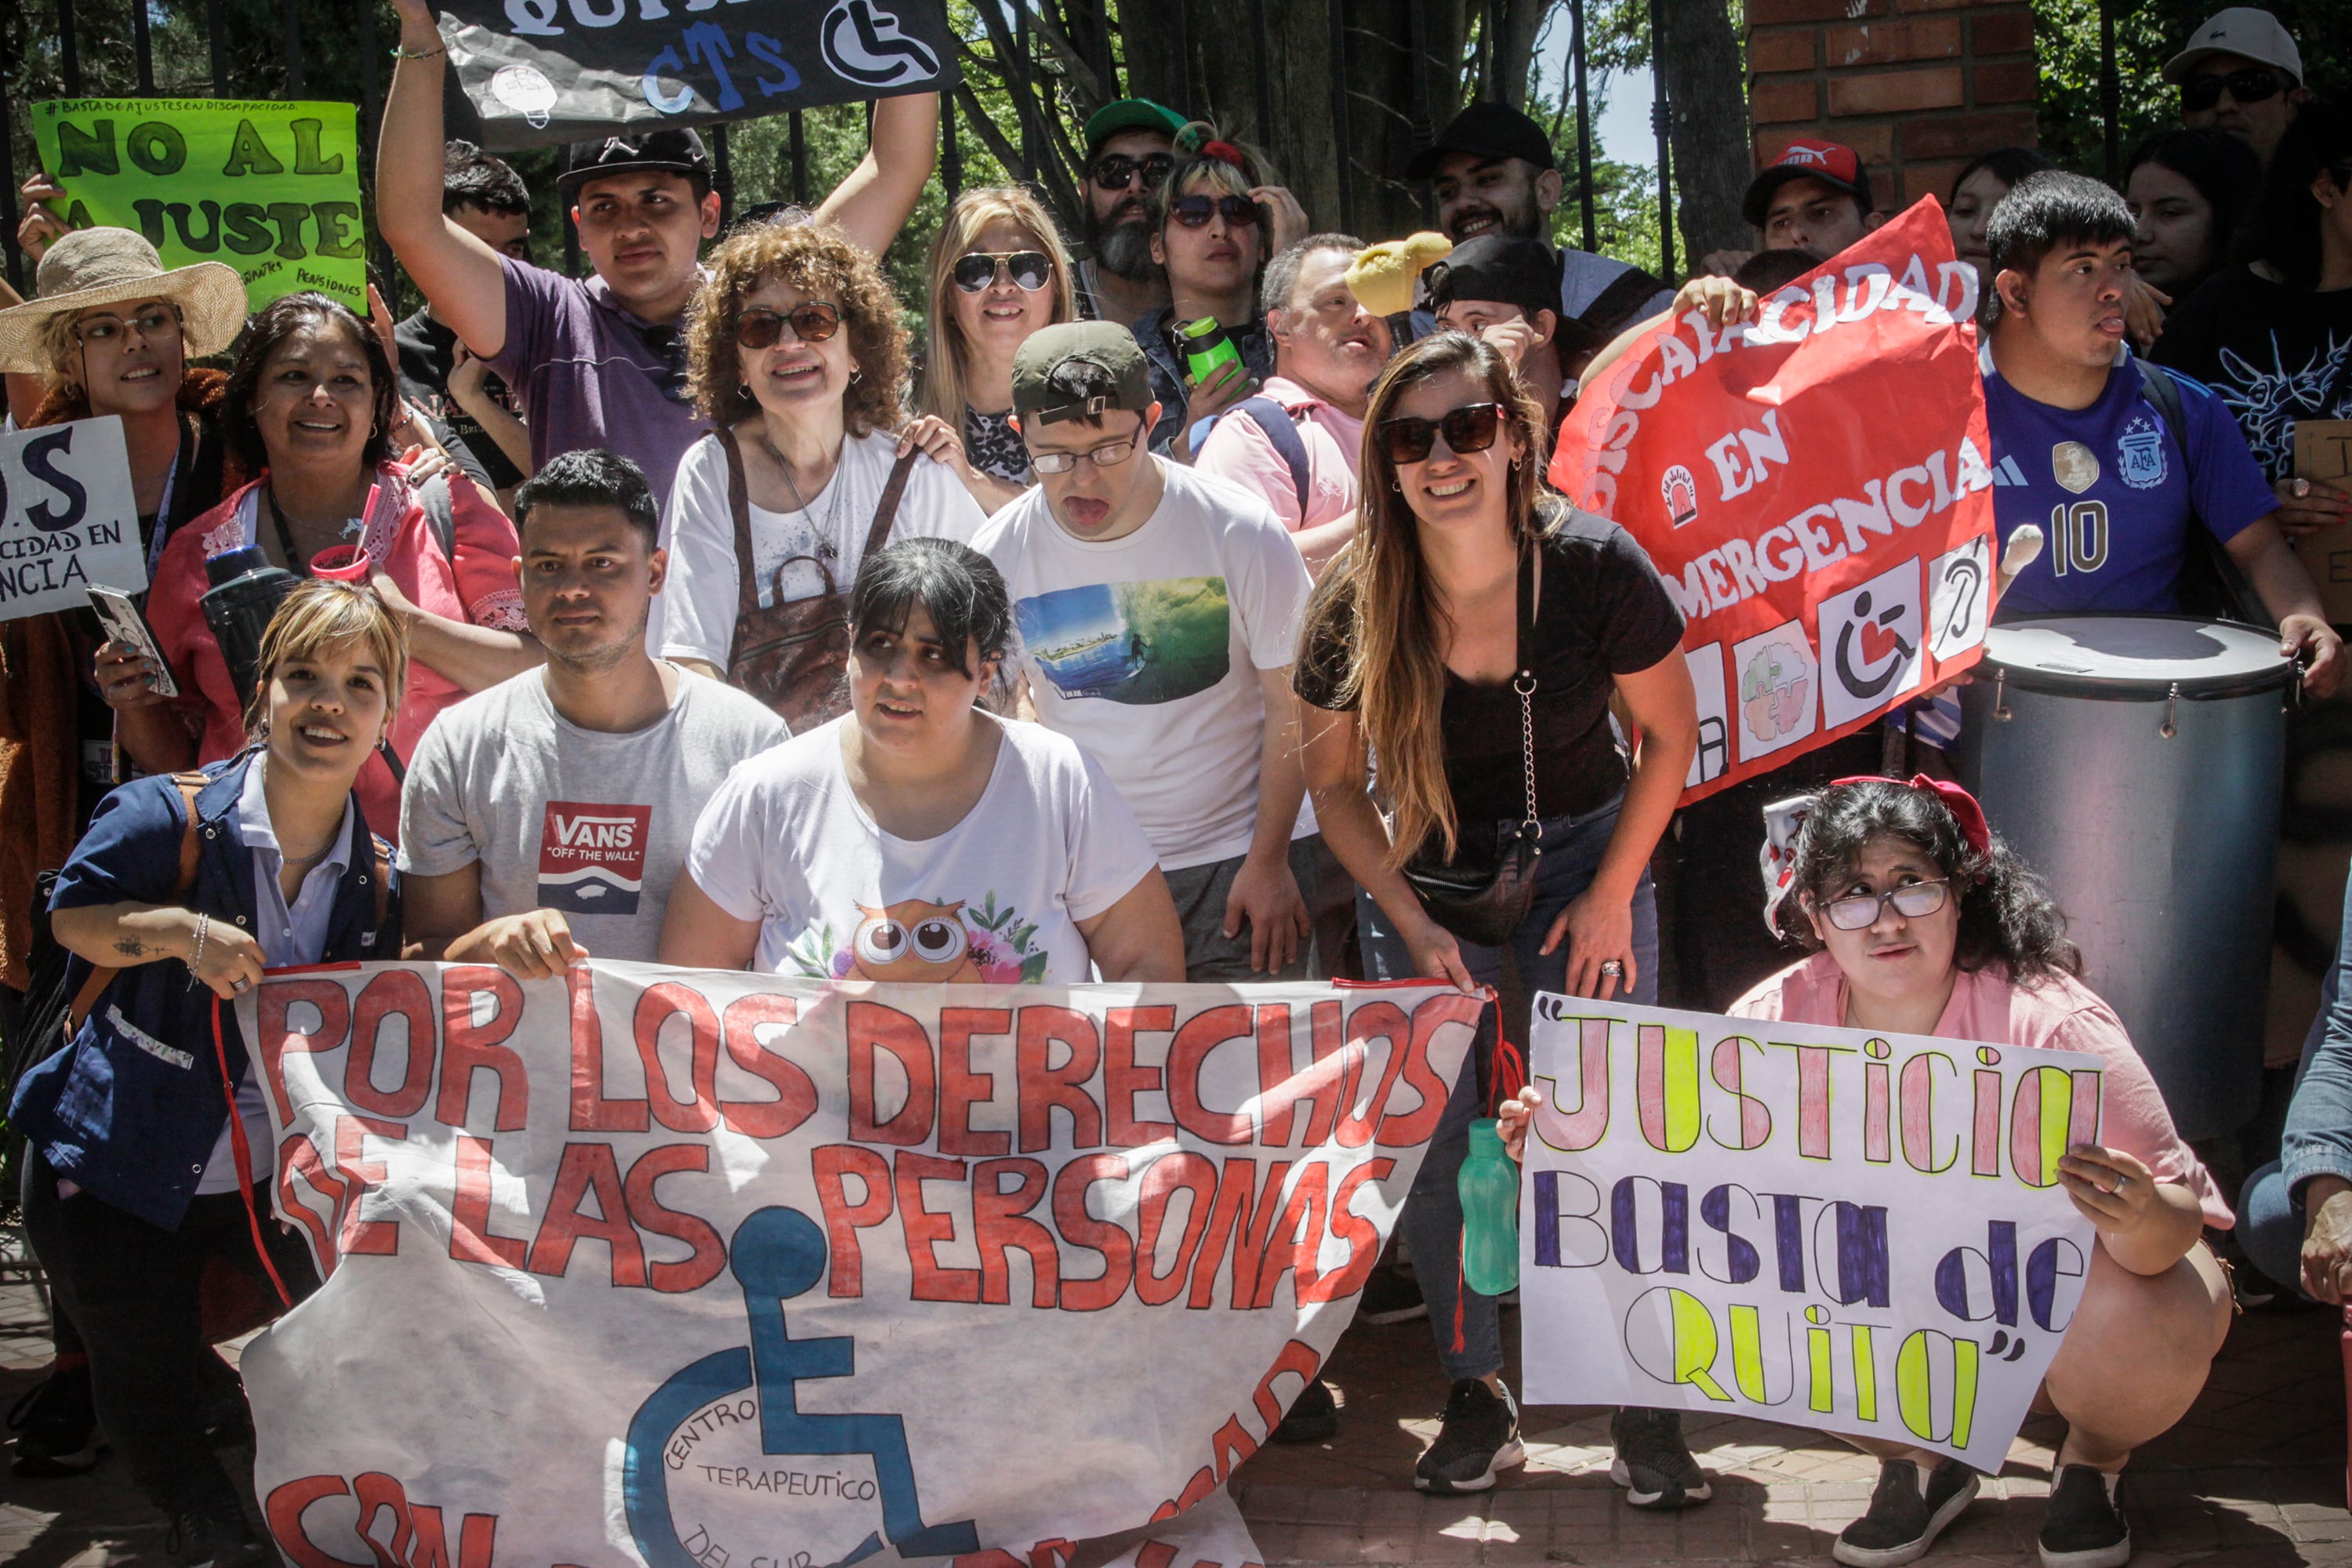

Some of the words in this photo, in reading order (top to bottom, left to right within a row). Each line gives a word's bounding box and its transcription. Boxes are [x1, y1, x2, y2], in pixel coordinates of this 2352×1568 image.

[641, 21, 801, 114] CTS
[58, 121, 187, 178] NO
[222, 118, 343, 177] AL
[296, 267, 361, 296] PENSIONES
[1704, 407, 1791, 503] EN
[2130, 446, 2157, 471] AFA
[87, 520, 122, 546] EN
[1657, 436, 1994, 619] MERGENCIA
[2051, 499, 2109, 578] 10
[555, 815, 637, 848] VANS
[579, 849, 602, 861] THE
[257, 965, 530, 1132] POR
[566, 967, 819, 1139] LOS
[845, 993, 1486, 1156] DERECHOS
[449, 1136, 728, 1294] LAS
[811, 1142, 1396, 1312] PERSONAS
[1934, 1219, 2085, 1334] de
[665, 1399, 756, 1471] CENTRO
